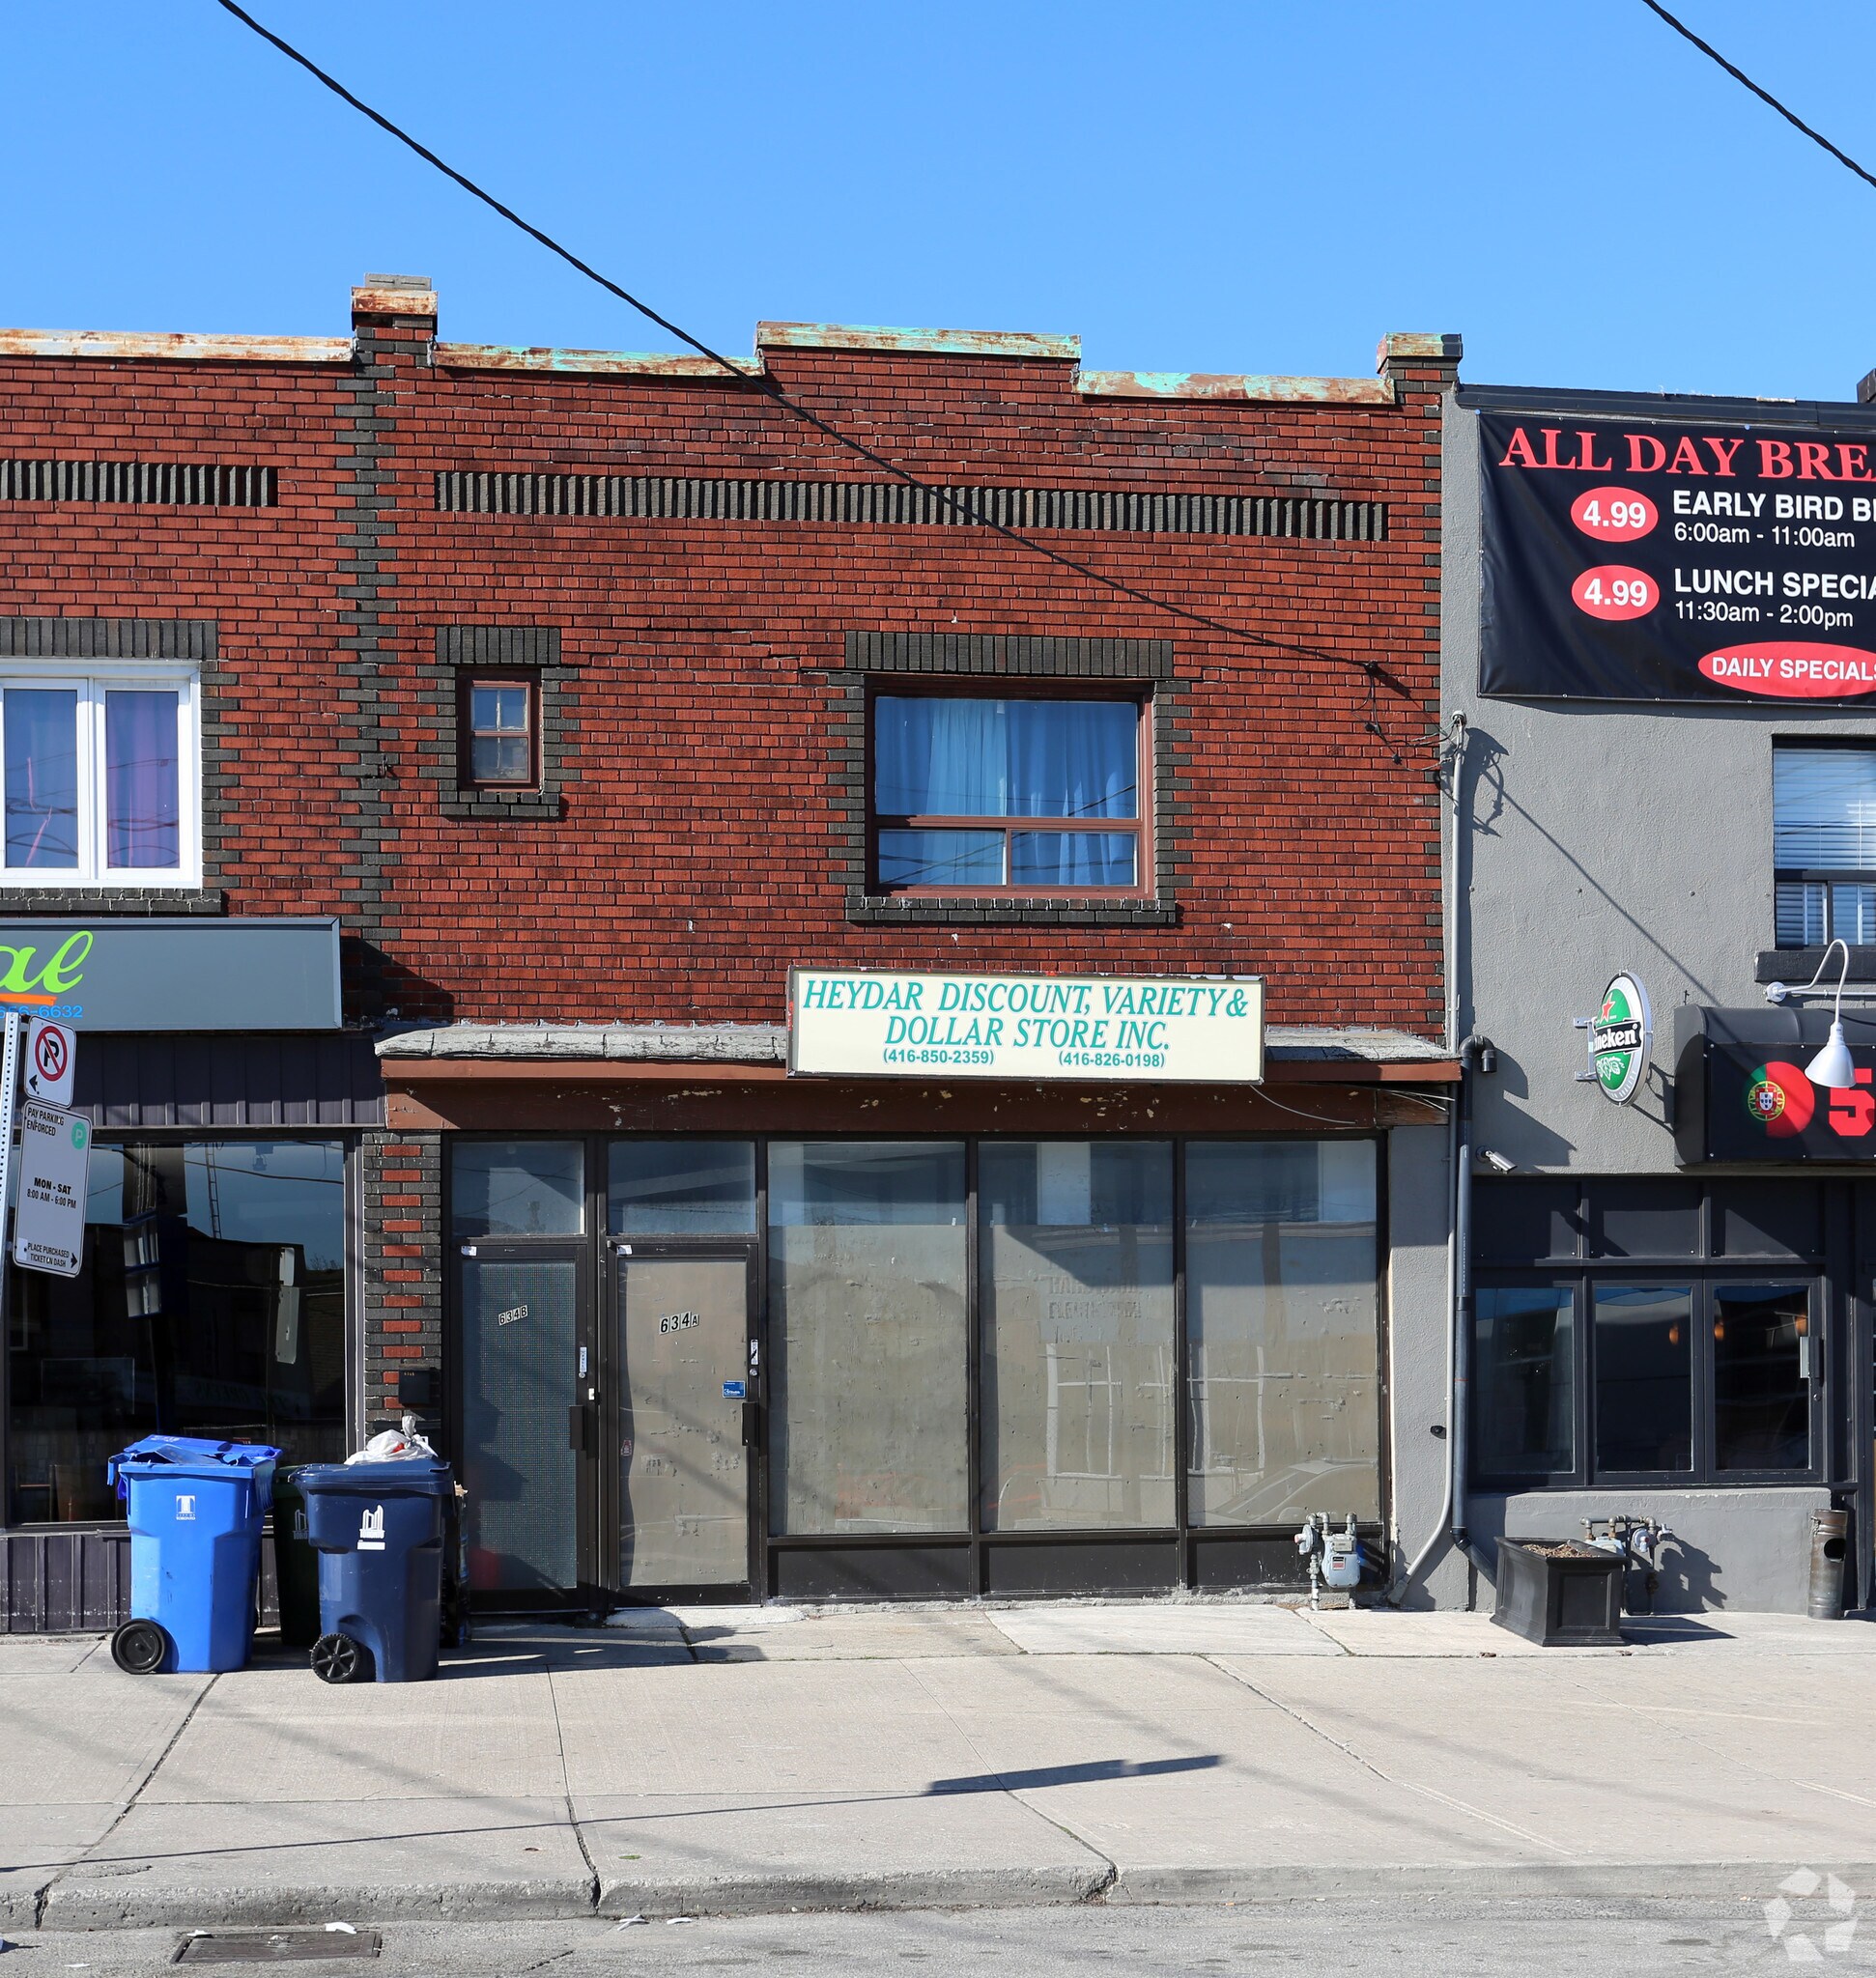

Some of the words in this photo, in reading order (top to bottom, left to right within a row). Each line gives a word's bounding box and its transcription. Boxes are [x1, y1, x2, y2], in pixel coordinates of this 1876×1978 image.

[1499, 428, 1612, 471] ALL
[1624, 435, 1745, 476] DAY
[1756, 440, 1876, 482] BRE
[1582, 500, 1646, 528] 4.99
[1673, 490, 1767, 518] EARLY
[1776, 494, 1844, 521] BIRD
[1852, 497, 1876, 523] B
[1674, 523, 1750, 544] 6:00am
[1773, 526, 1856, 548] 11:00am
[1584, 579, 1648, 607] 4.99
[1674, 568, 1774, 596] LUNCH
[1675, 601, 1760, 622] 11:30am
[1779, 604, 1854, 631] 2:00pm
[1712, 657, 1775, 678] DAILY
[1779, 659, 1876, 681] SPECIAL
[802, 980, 924, 1010] HEYDAR
[938, 982, 1093, 1016] DISCOUNT,
[885, 1016, 1004, 1046] DOLLAR
[1013, 1018, 1109, 1049] STORE
[1116, 1020, 1169, 1050] INC.
[883, 1048, 995, 1064] (416-850-2359)
[1059, 1051, 1165, 1067] (416-826-0198)
[27, 1119, 56, 1136] ENFORCED
[28, 1108, 39, 1118] PAY
[39, 1111, 65, 1126] PARKING
[34, 1177, 52, 1190] MON
[57, 1183, 71, 1195] SAT
[27, 1188, 39, 1200] 8:00
[40, 1192, 50, 1202] AM
[54, 1196, 67, 1206] 6:00
[67, 1199, 76, 1209] PM
[28, 1242, 43, 1253] PLACE
[43, 1246, 70, 1258] PURCHASED
[30, 1254, 45, 1263] TICKET
[54, 1258, 67, 1267] DASH
[499, 1307, 527, 1324] 634B
[660, 1313, 697, 1333] 634A
